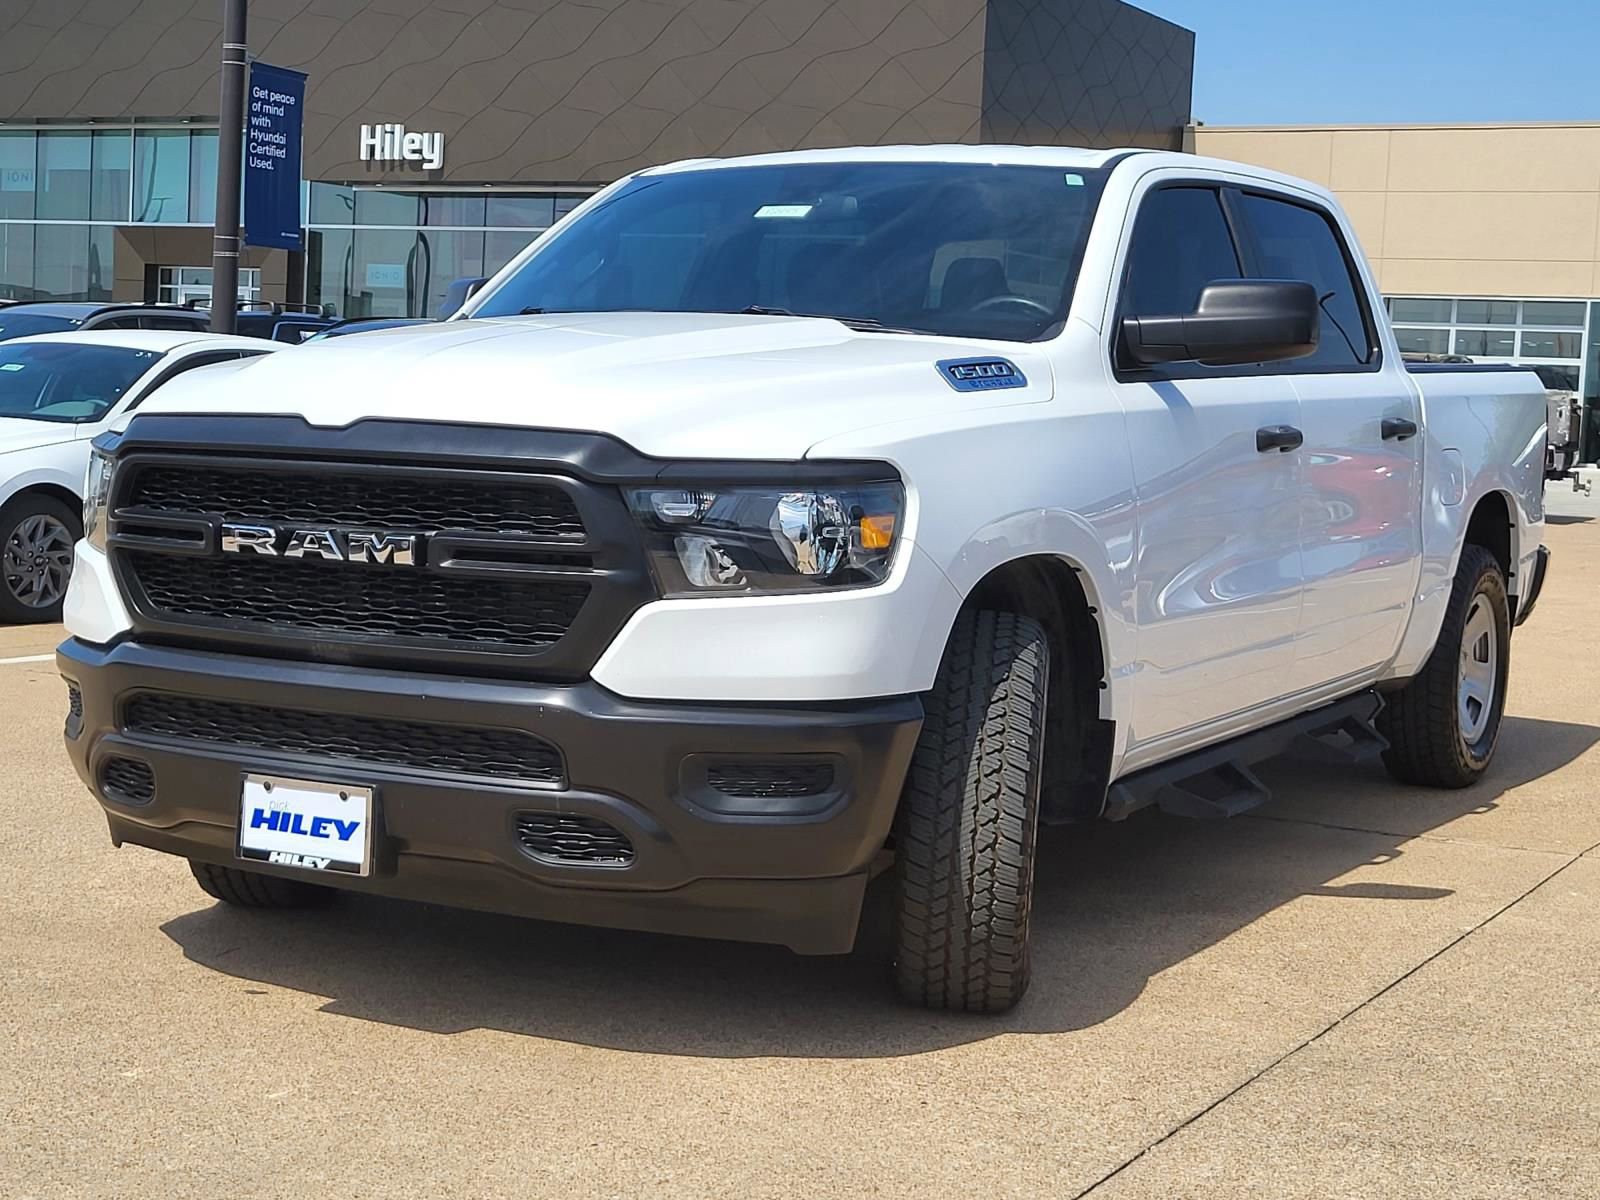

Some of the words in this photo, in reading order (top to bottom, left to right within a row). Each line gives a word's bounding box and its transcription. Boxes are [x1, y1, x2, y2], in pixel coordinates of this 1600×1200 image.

[252, 86, 269, 100] Get
[269, 90, 295, 105] peace
[251, 101, 262, 112] of
[263, 103, 284, 116] mind
[251, 114, 271, 127] with
[250, 128, 287, 145] Hyundai
[249, 142, 286, 159] Certified
[359, 123, 444, 170] Hiley
[249, 156, 274, 170] Used.
[950, 364, 1010, 379] 1500
[221, 522, 415, 566] RAM
[250, 807, 361, 841] HILEY
[268, 850, 332, 869] HILEY
